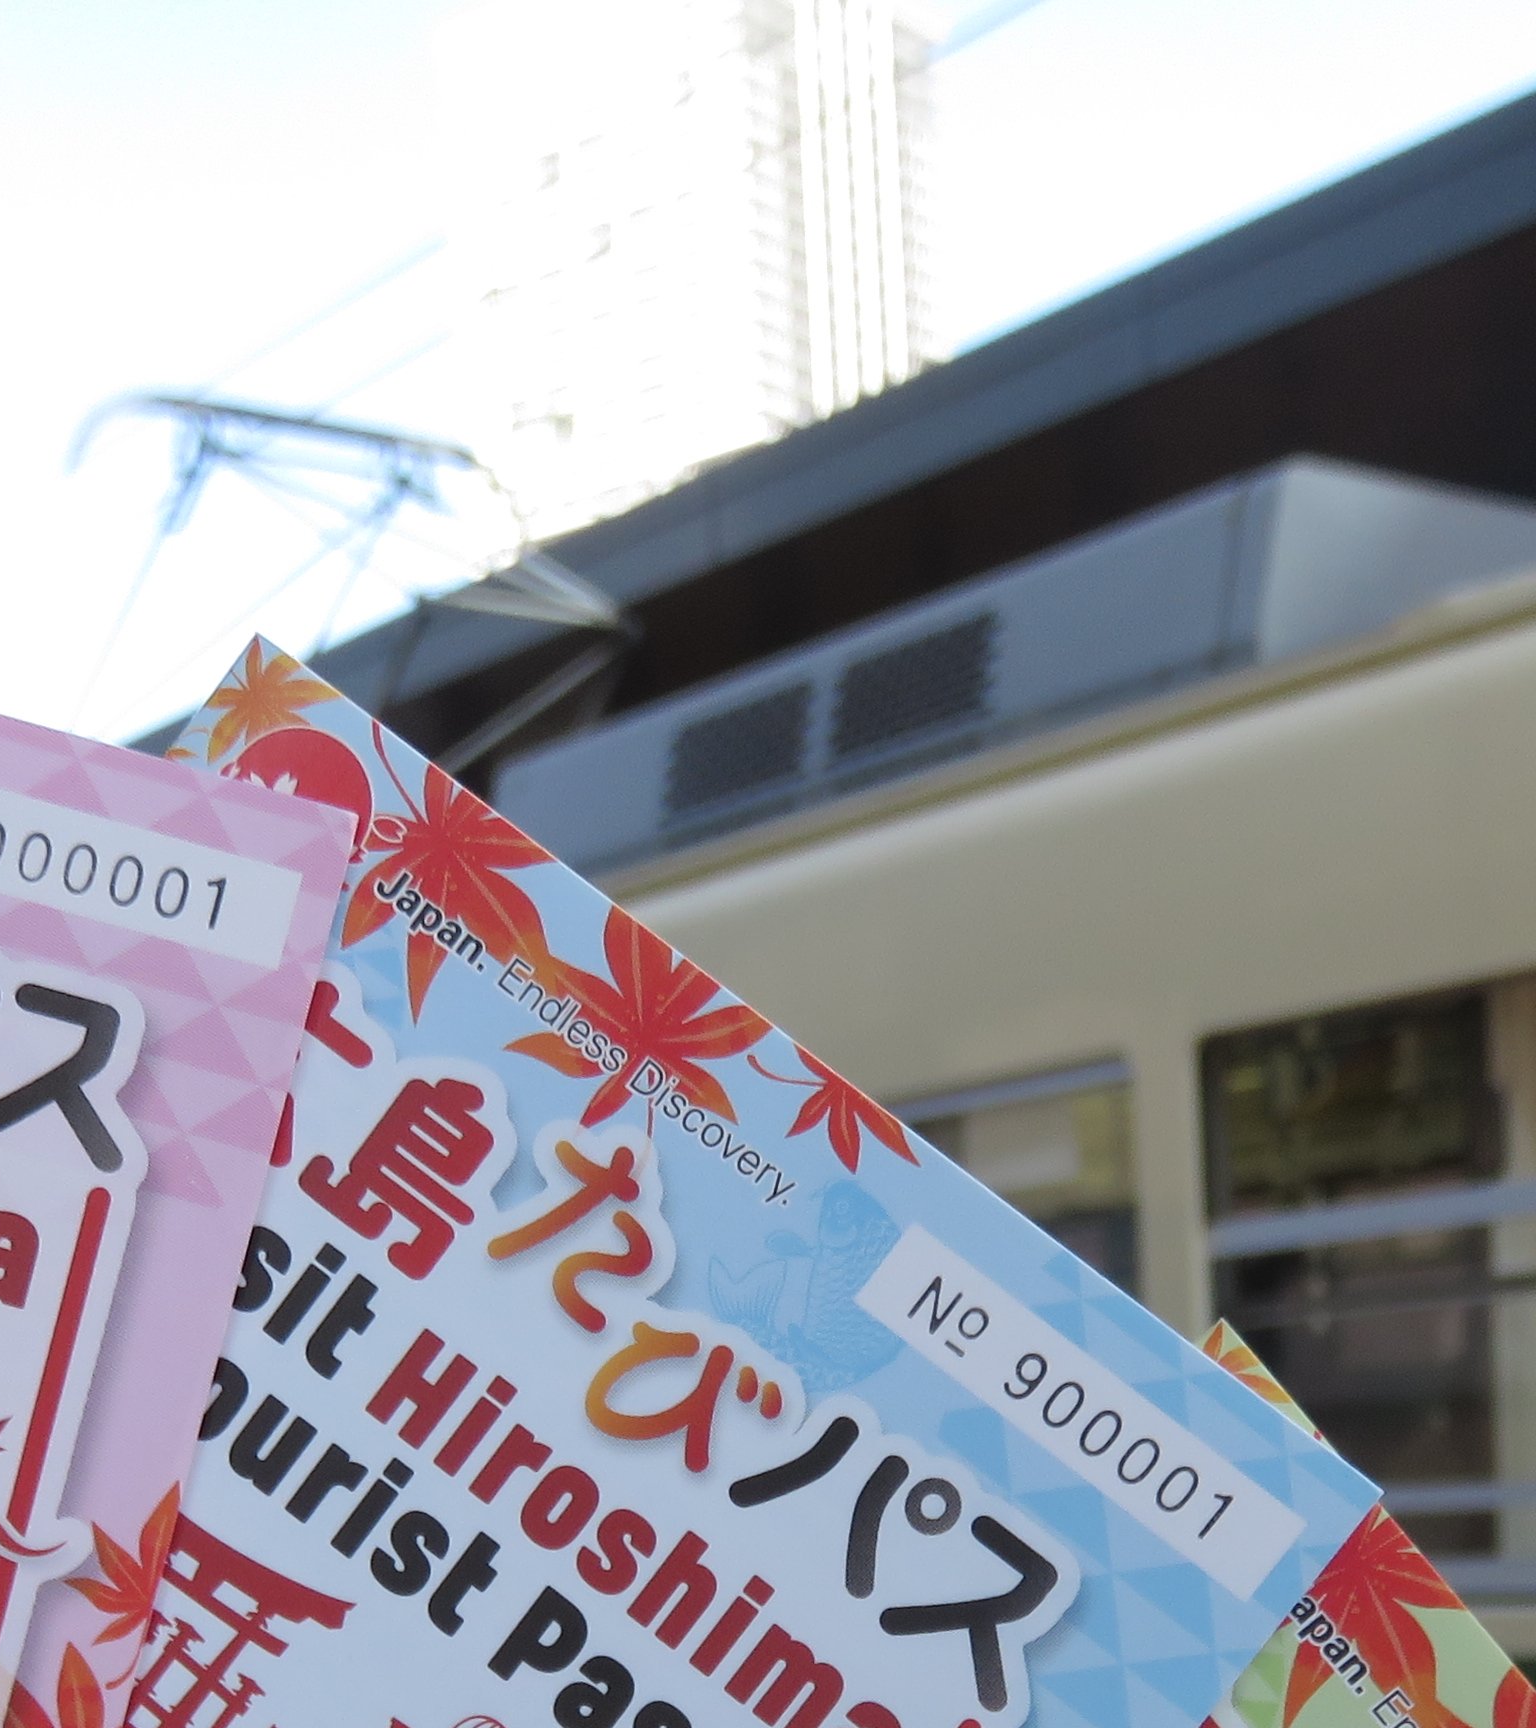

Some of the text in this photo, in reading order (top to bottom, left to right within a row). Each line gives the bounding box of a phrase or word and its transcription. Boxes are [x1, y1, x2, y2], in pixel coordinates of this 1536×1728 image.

[375, 872, 795, 1205] Japan. Endless Discovery.
[1003, 1353, 1234, 1539] 900001
